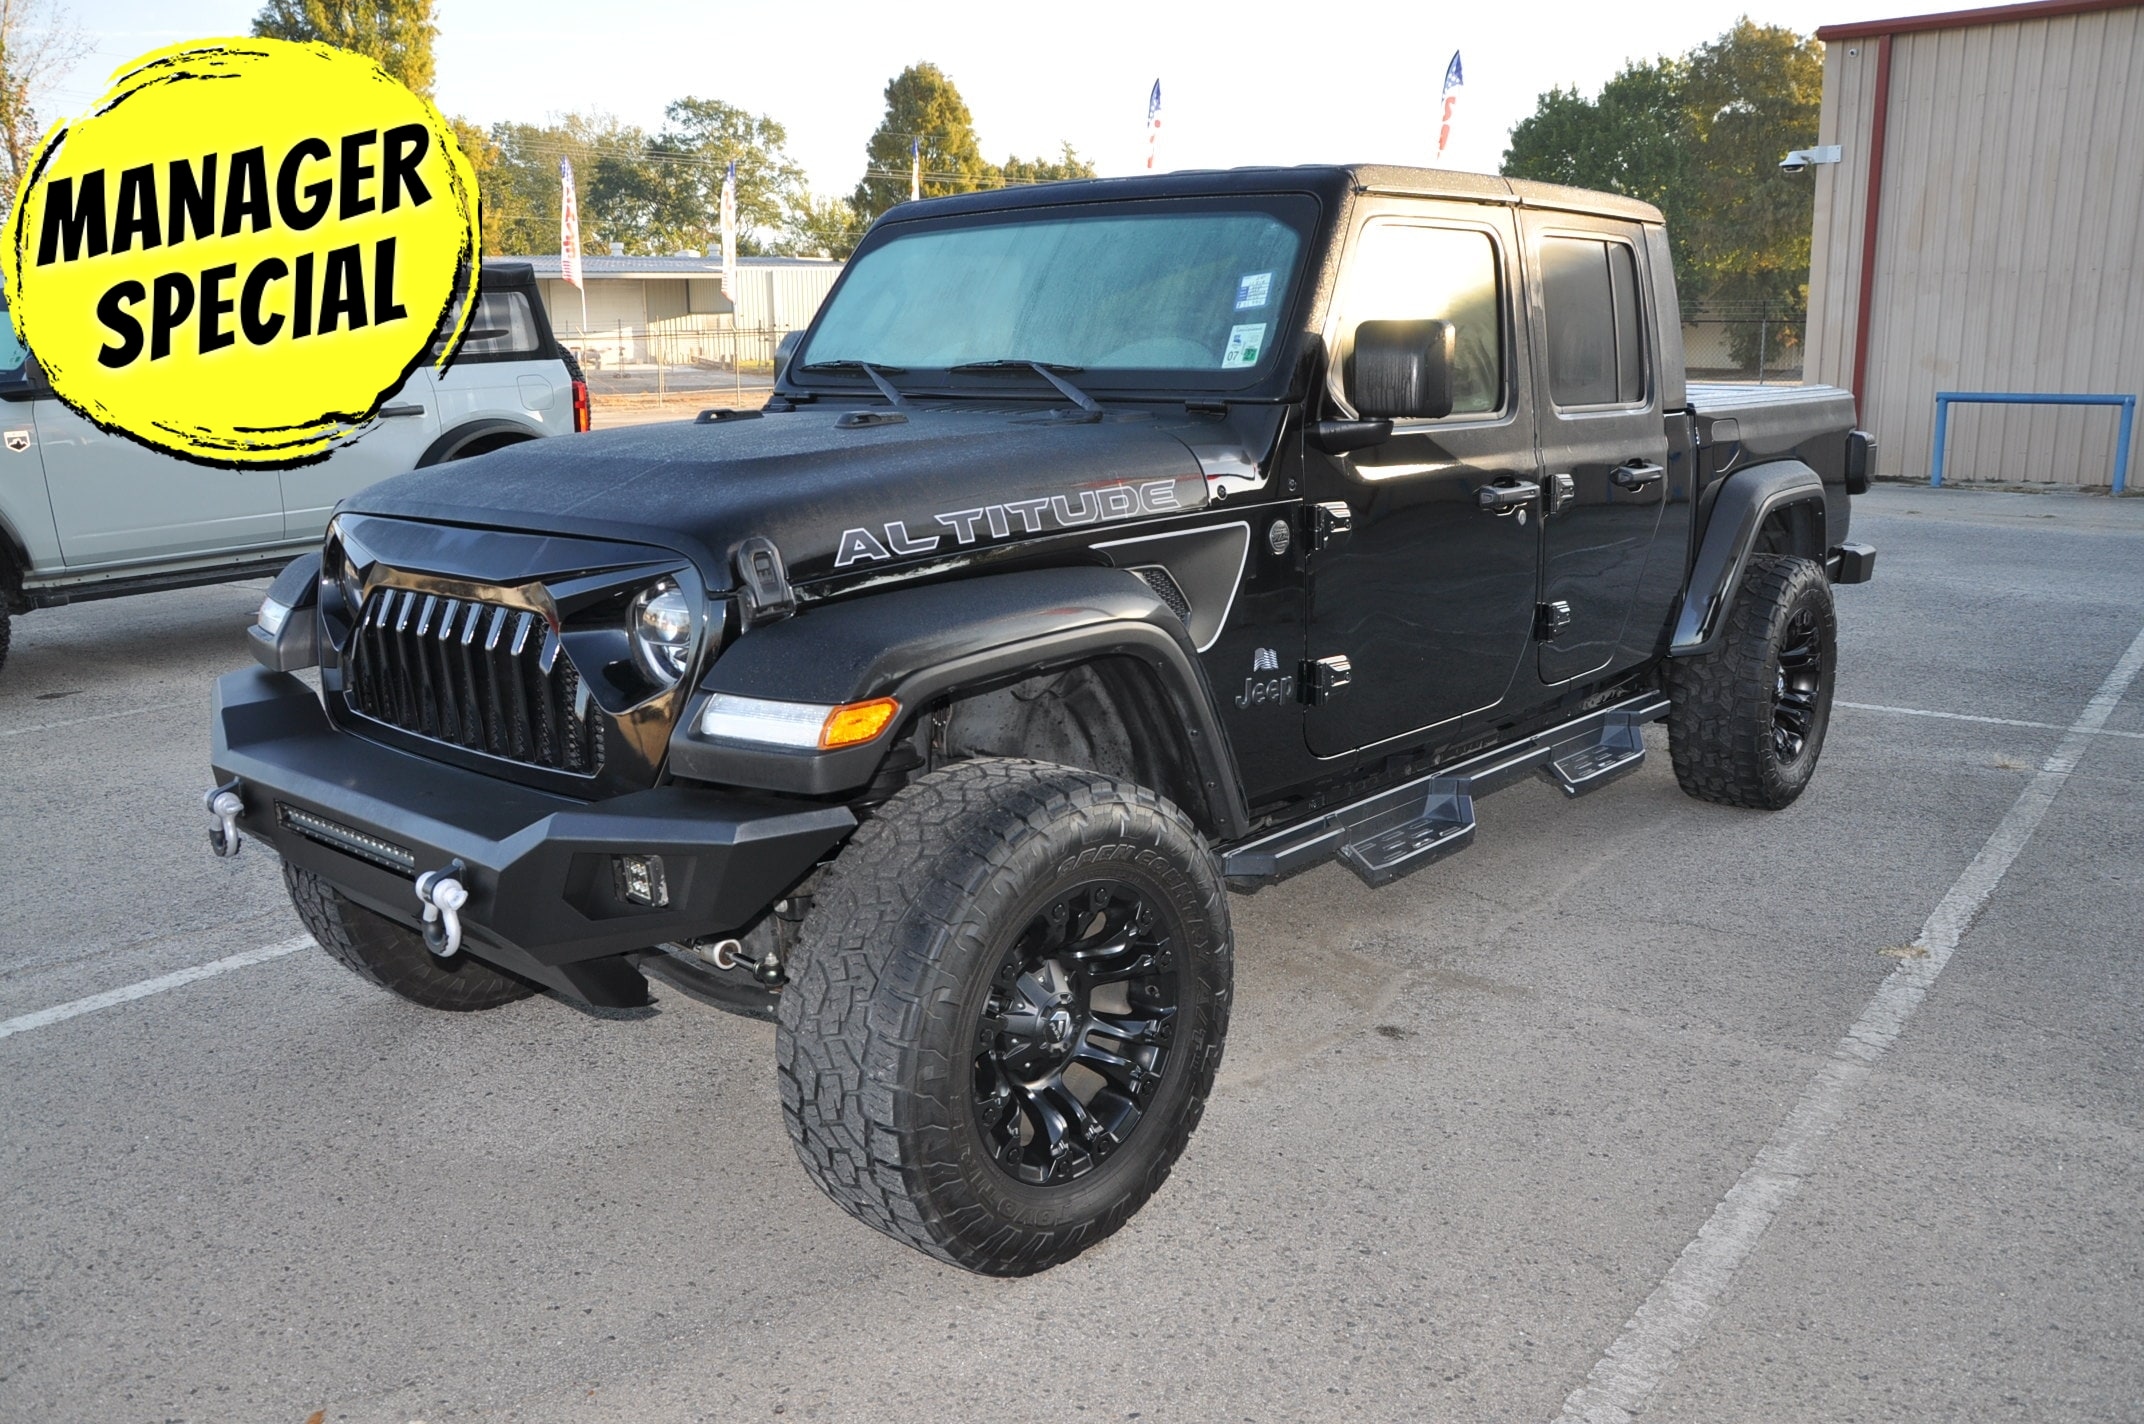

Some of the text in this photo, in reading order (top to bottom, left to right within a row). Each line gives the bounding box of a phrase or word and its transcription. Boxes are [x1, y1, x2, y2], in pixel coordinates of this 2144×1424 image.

[1227, 350, 1239, 361] 07
[834, 479, 1181, 567] ALTITUDE
[1235, 676, 1294, 709] Jeep
[1056, 843, 1136, 876] OPEN
